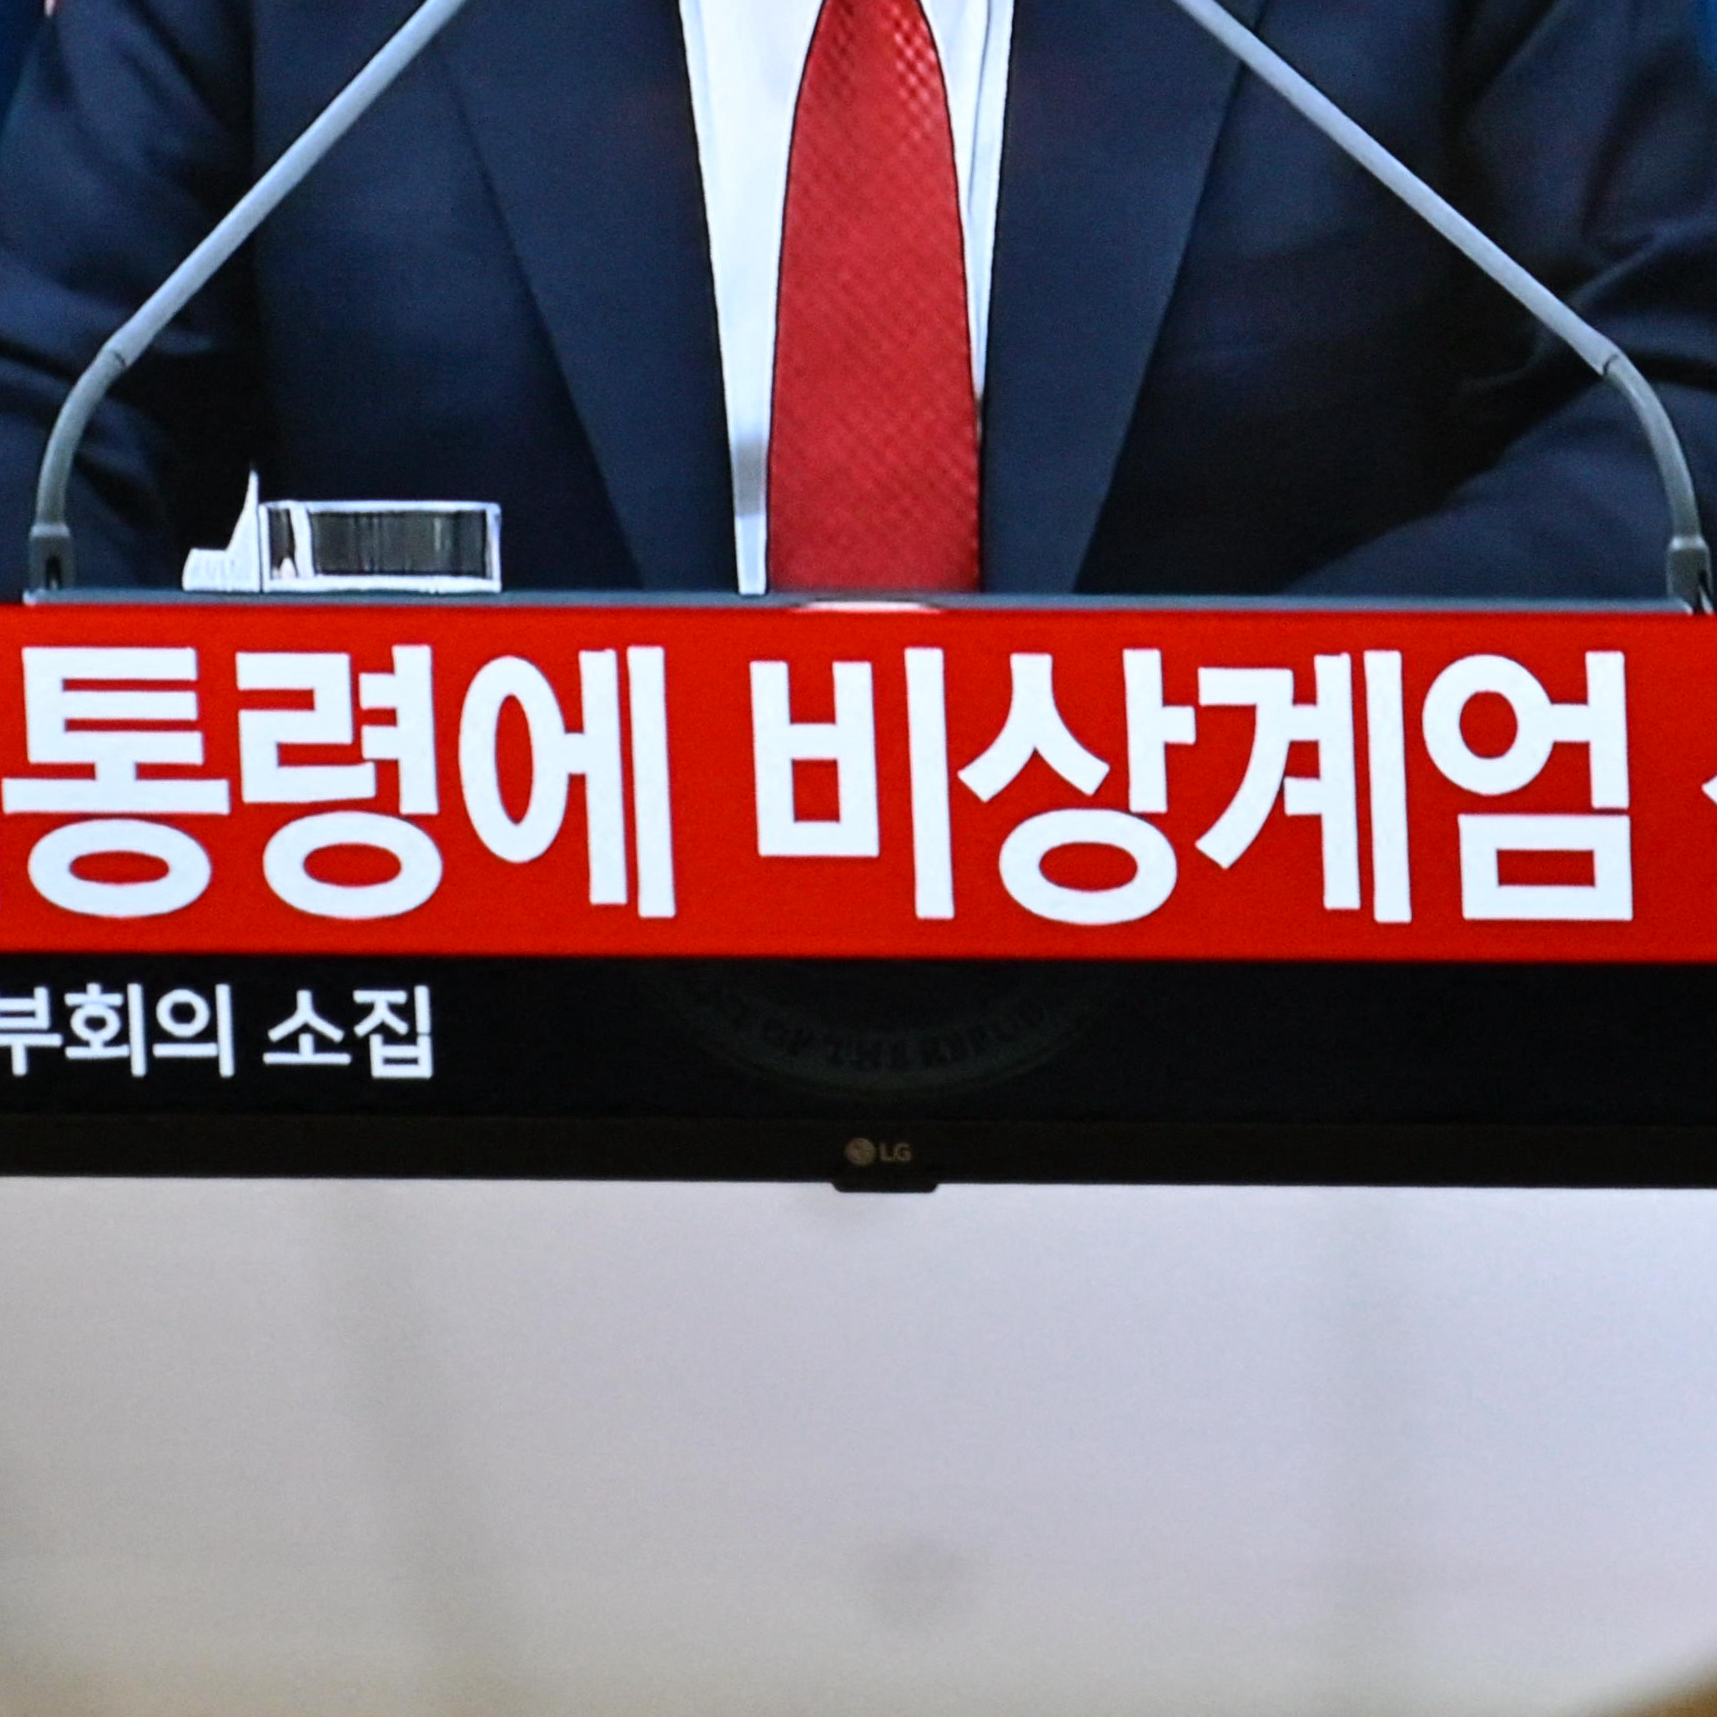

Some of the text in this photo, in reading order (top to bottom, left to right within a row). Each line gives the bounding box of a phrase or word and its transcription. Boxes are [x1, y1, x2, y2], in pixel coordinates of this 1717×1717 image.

[748, 644, 1634, 927] 비상계엄
[261, 984, 434, 1080] 소집
[878, 1141, 915, 1164] LG
